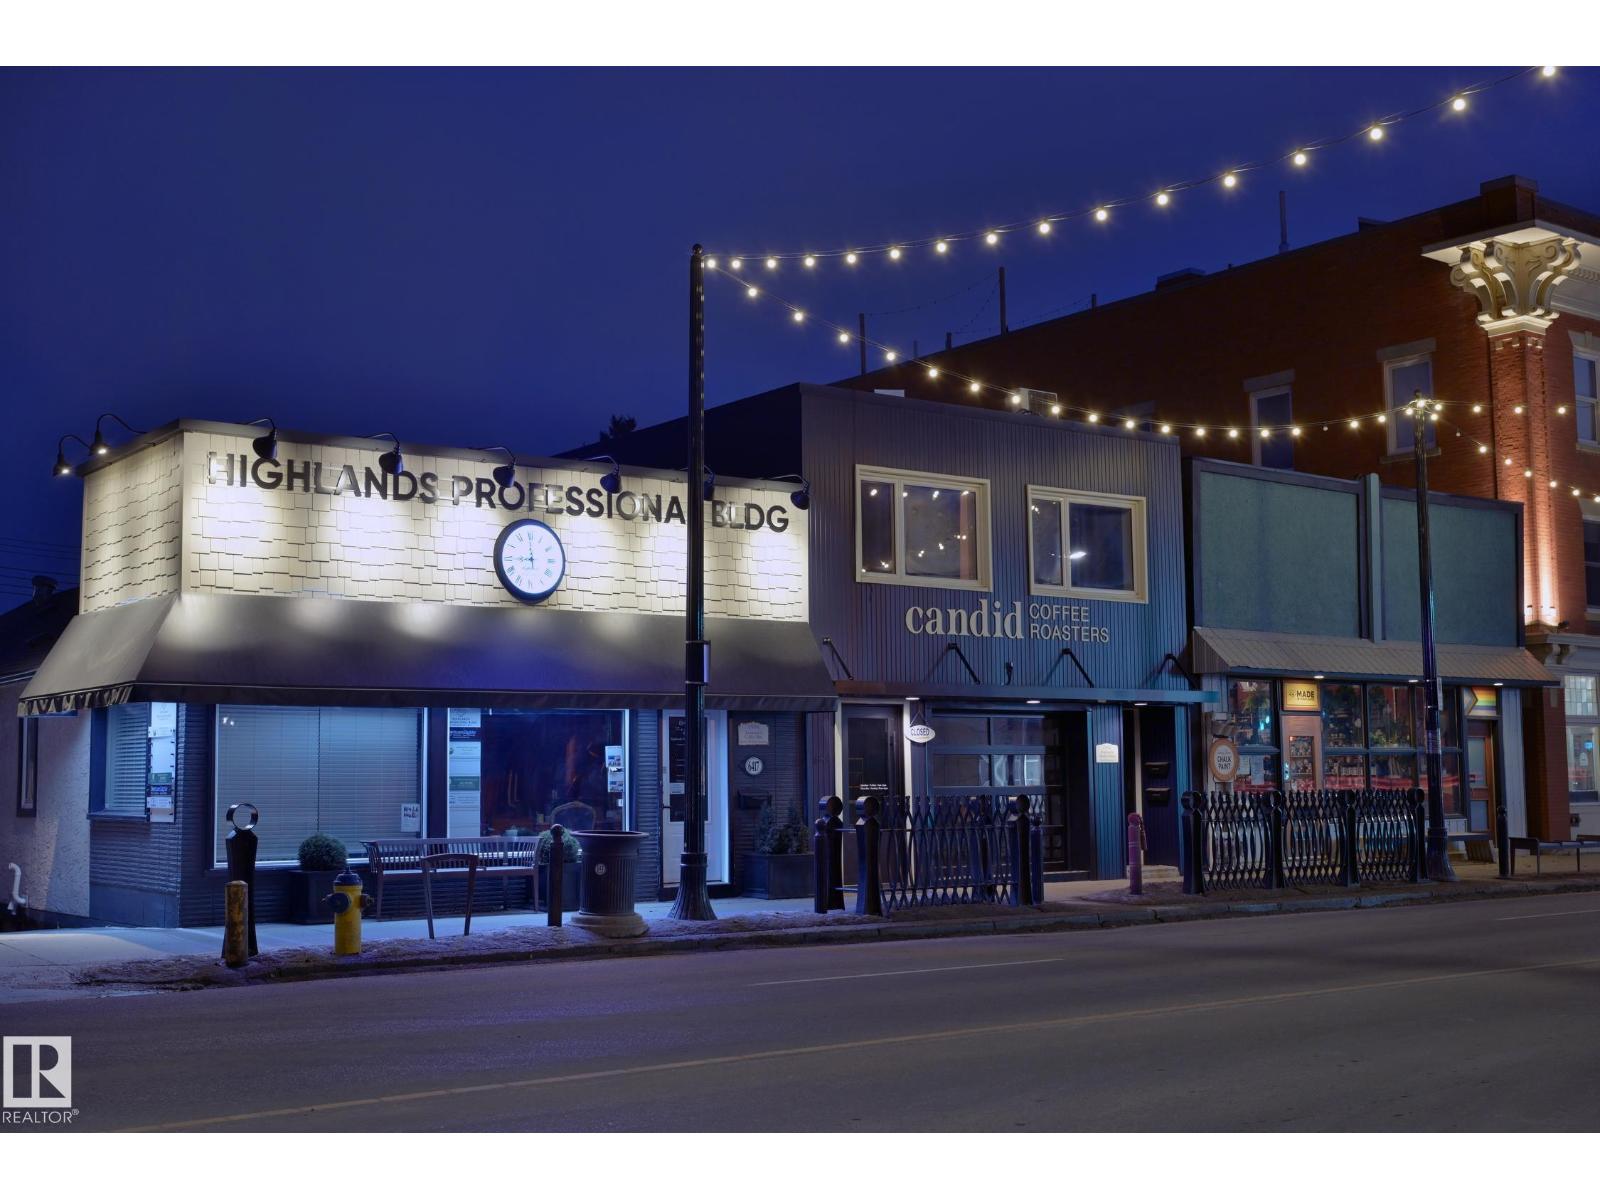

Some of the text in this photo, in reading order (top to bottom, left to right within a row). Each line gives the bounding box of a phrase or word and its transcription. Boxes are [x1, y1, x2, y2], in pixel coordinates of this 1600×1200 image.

[208, 451, 789, 533] HIGHLANDS PROFESSIONA BLDG
[905, 598, 1025, 639] candid
[1029, 603, 1089, 622] COFFEE
[1029, 624, 1109, 643] ROASTERS
[1297, 690, 1315, 698] MADE
